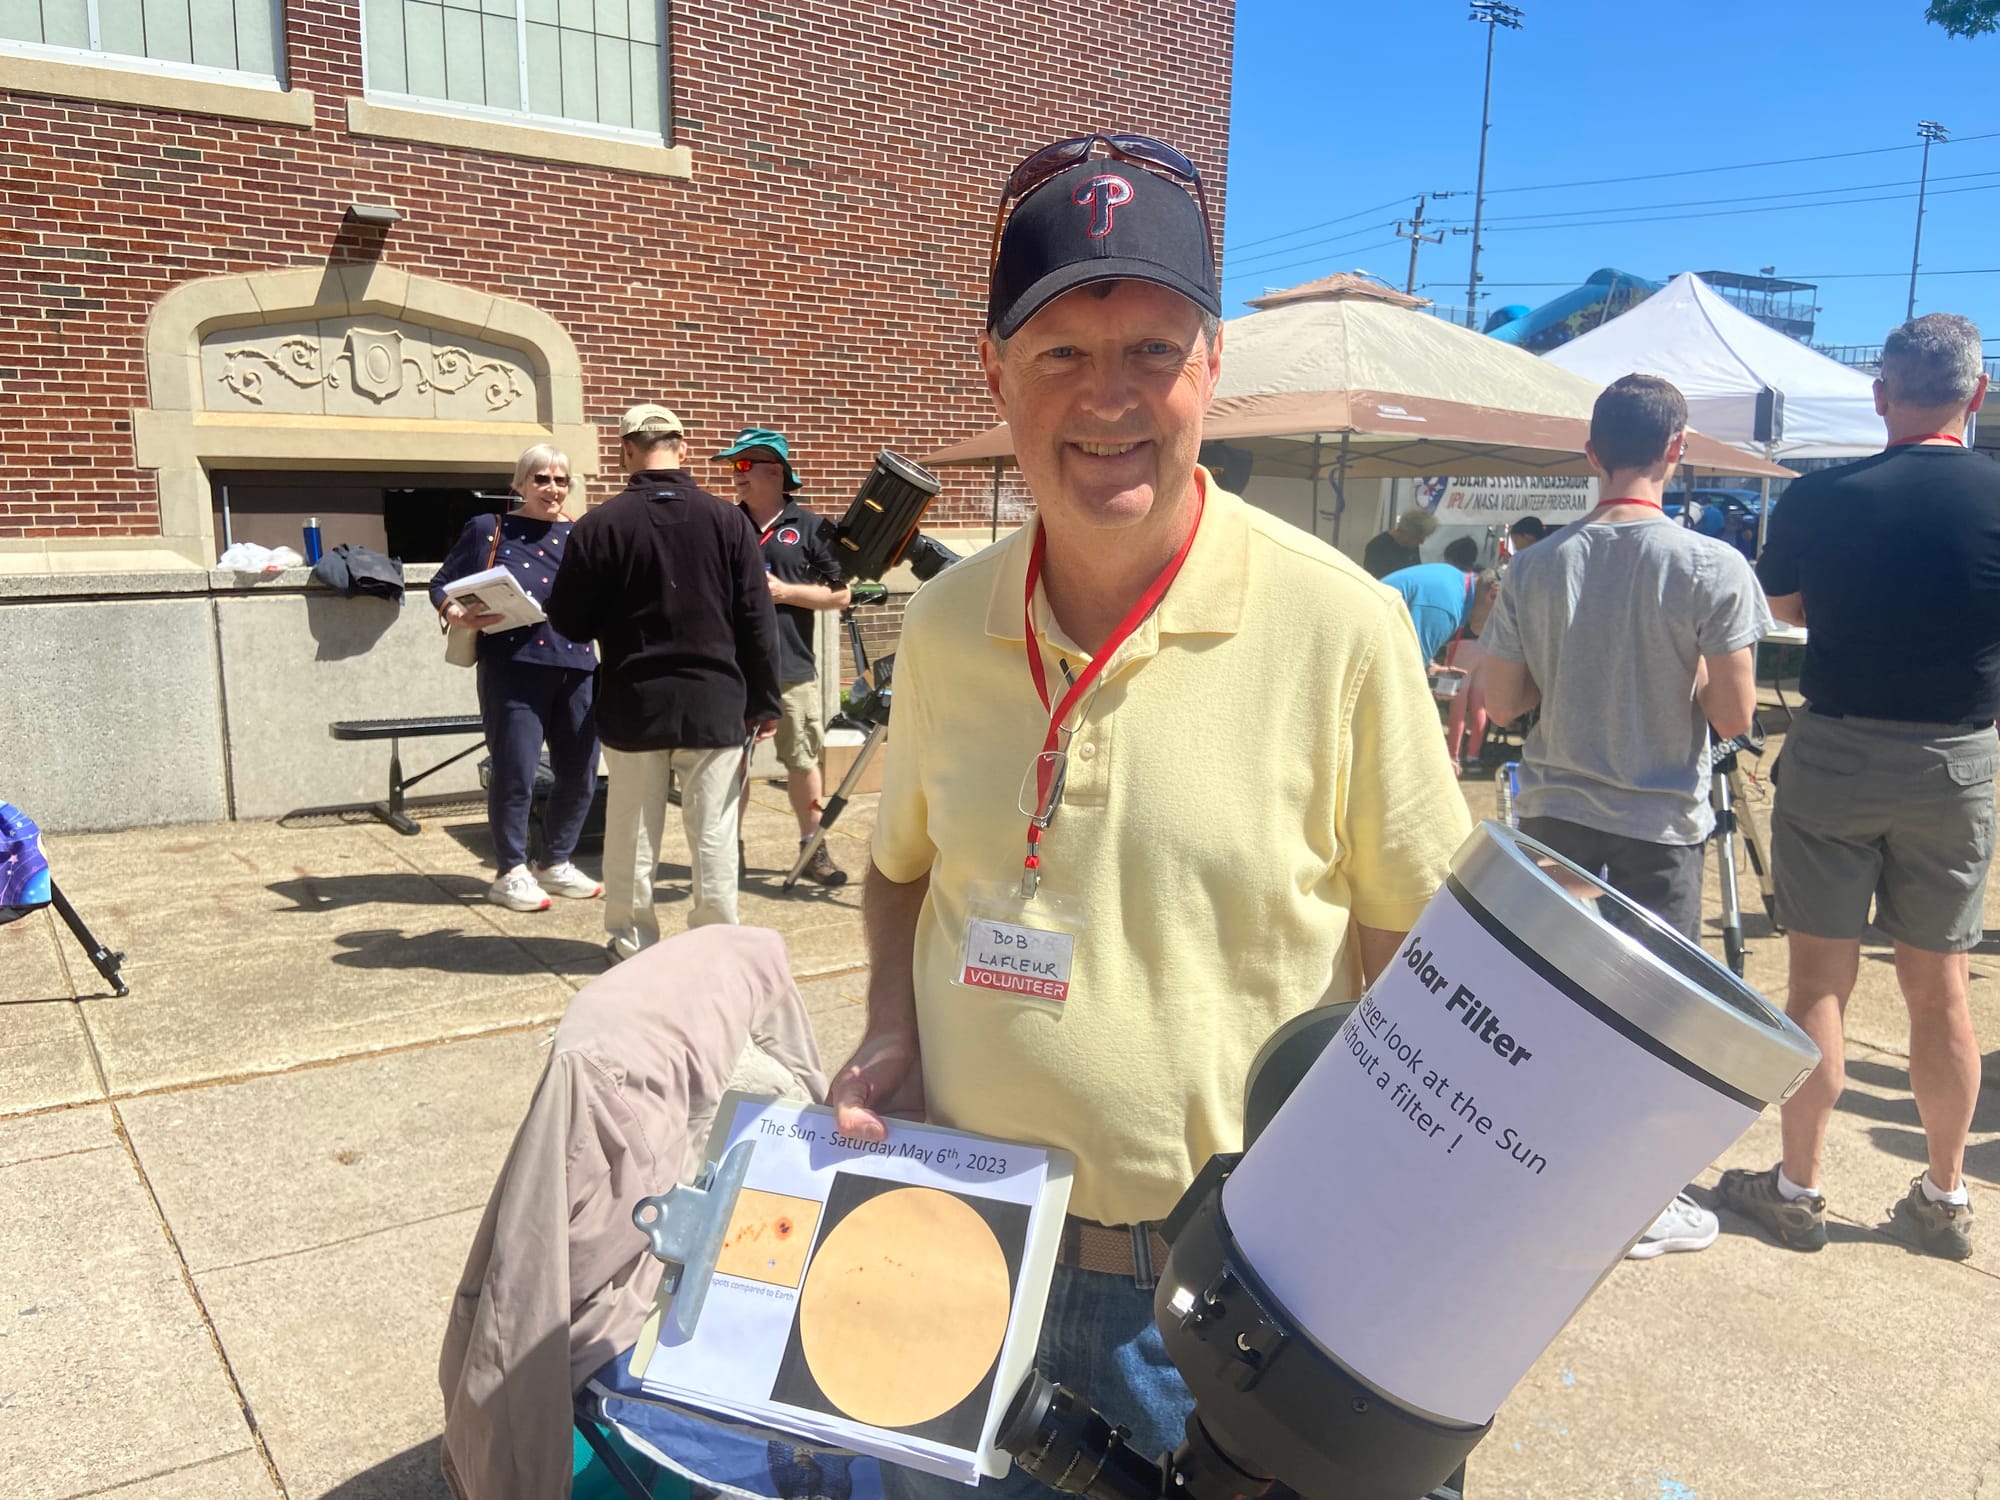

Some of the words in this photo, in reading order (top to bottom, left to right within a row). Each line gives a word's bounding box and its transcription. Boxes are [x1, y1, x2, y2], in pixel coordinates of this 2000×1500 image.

[1072, 174, 1135, 239] P
[969, 969, 1065, 997] VOLUNTEER
[979, 952, 1058, 978] LAFLEUR
[1402, 936, 1448, 994] Solar
[1445, 983, 1532, 1066] Filter
[1361, 996, 1387, 1030] ever
[1384, 1022, 1423, 1074] look
[1422, 1070, 1450, 1098] at
[1449, 1091, 1493, 1135] the
[1495, 1128, 1547, 1174] Sun
[1376, 1071, 1391, 1090] a
[1390, 1083, 1445, 1139] filter
[760, 1119, 785, 1137] The
[788, 1124, 816, 1142] Sun
[829, 1131, 897, 1158] Saturday
[899, 1143, 934, 1164] May
[966, 1154, 1007, 1174] 2023
[730, 1282, 766, 1295] compared
[766, 1288, 774, 1297] to
[775, 1289, 794, 1301] Earth
